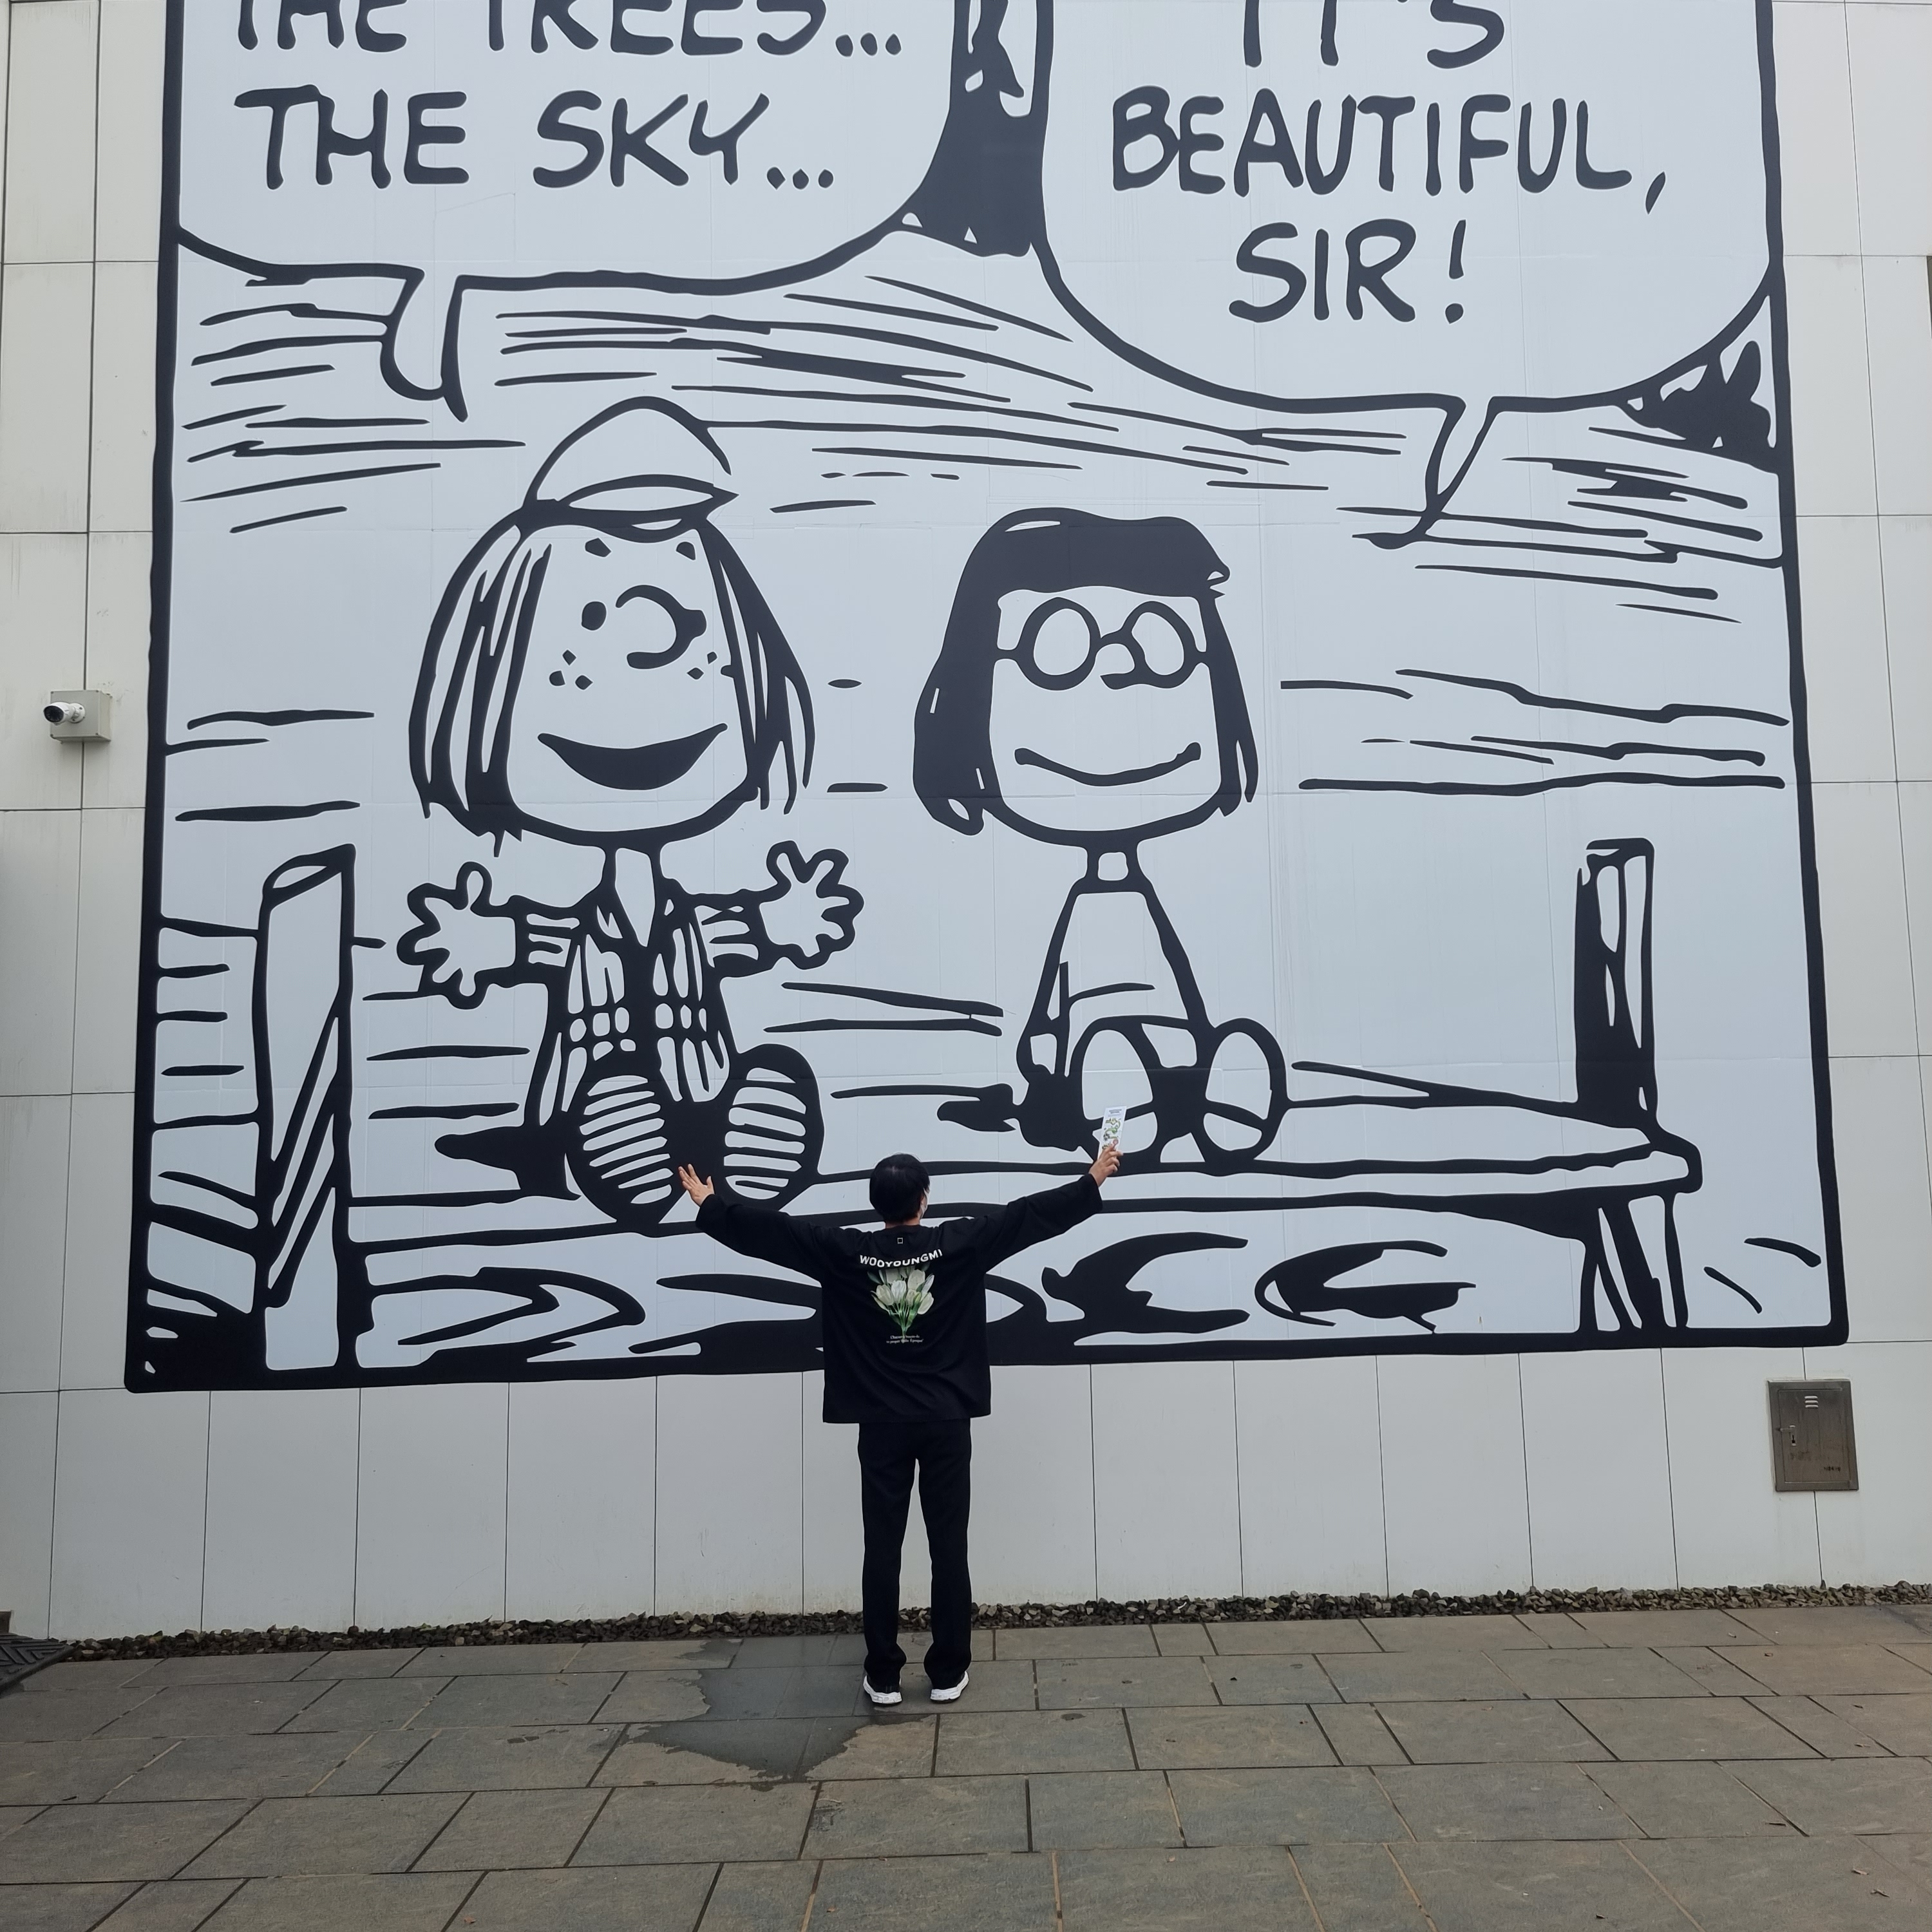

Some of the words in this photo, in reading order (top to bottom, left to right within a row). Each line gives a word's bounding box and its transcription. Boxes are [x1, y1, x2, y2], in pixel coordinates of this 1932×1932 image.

[1242, 0, 1506, 70] IS
[232, 84, 470, 191] THE
[532, 90, 835, 190] SKY...
[1112, 85, 1667, 215] BEAUTIFUL,
[1228, 218, 1467, 325] SIR!
[859, 1249, 943, 1268] WOOYOUNGMI
